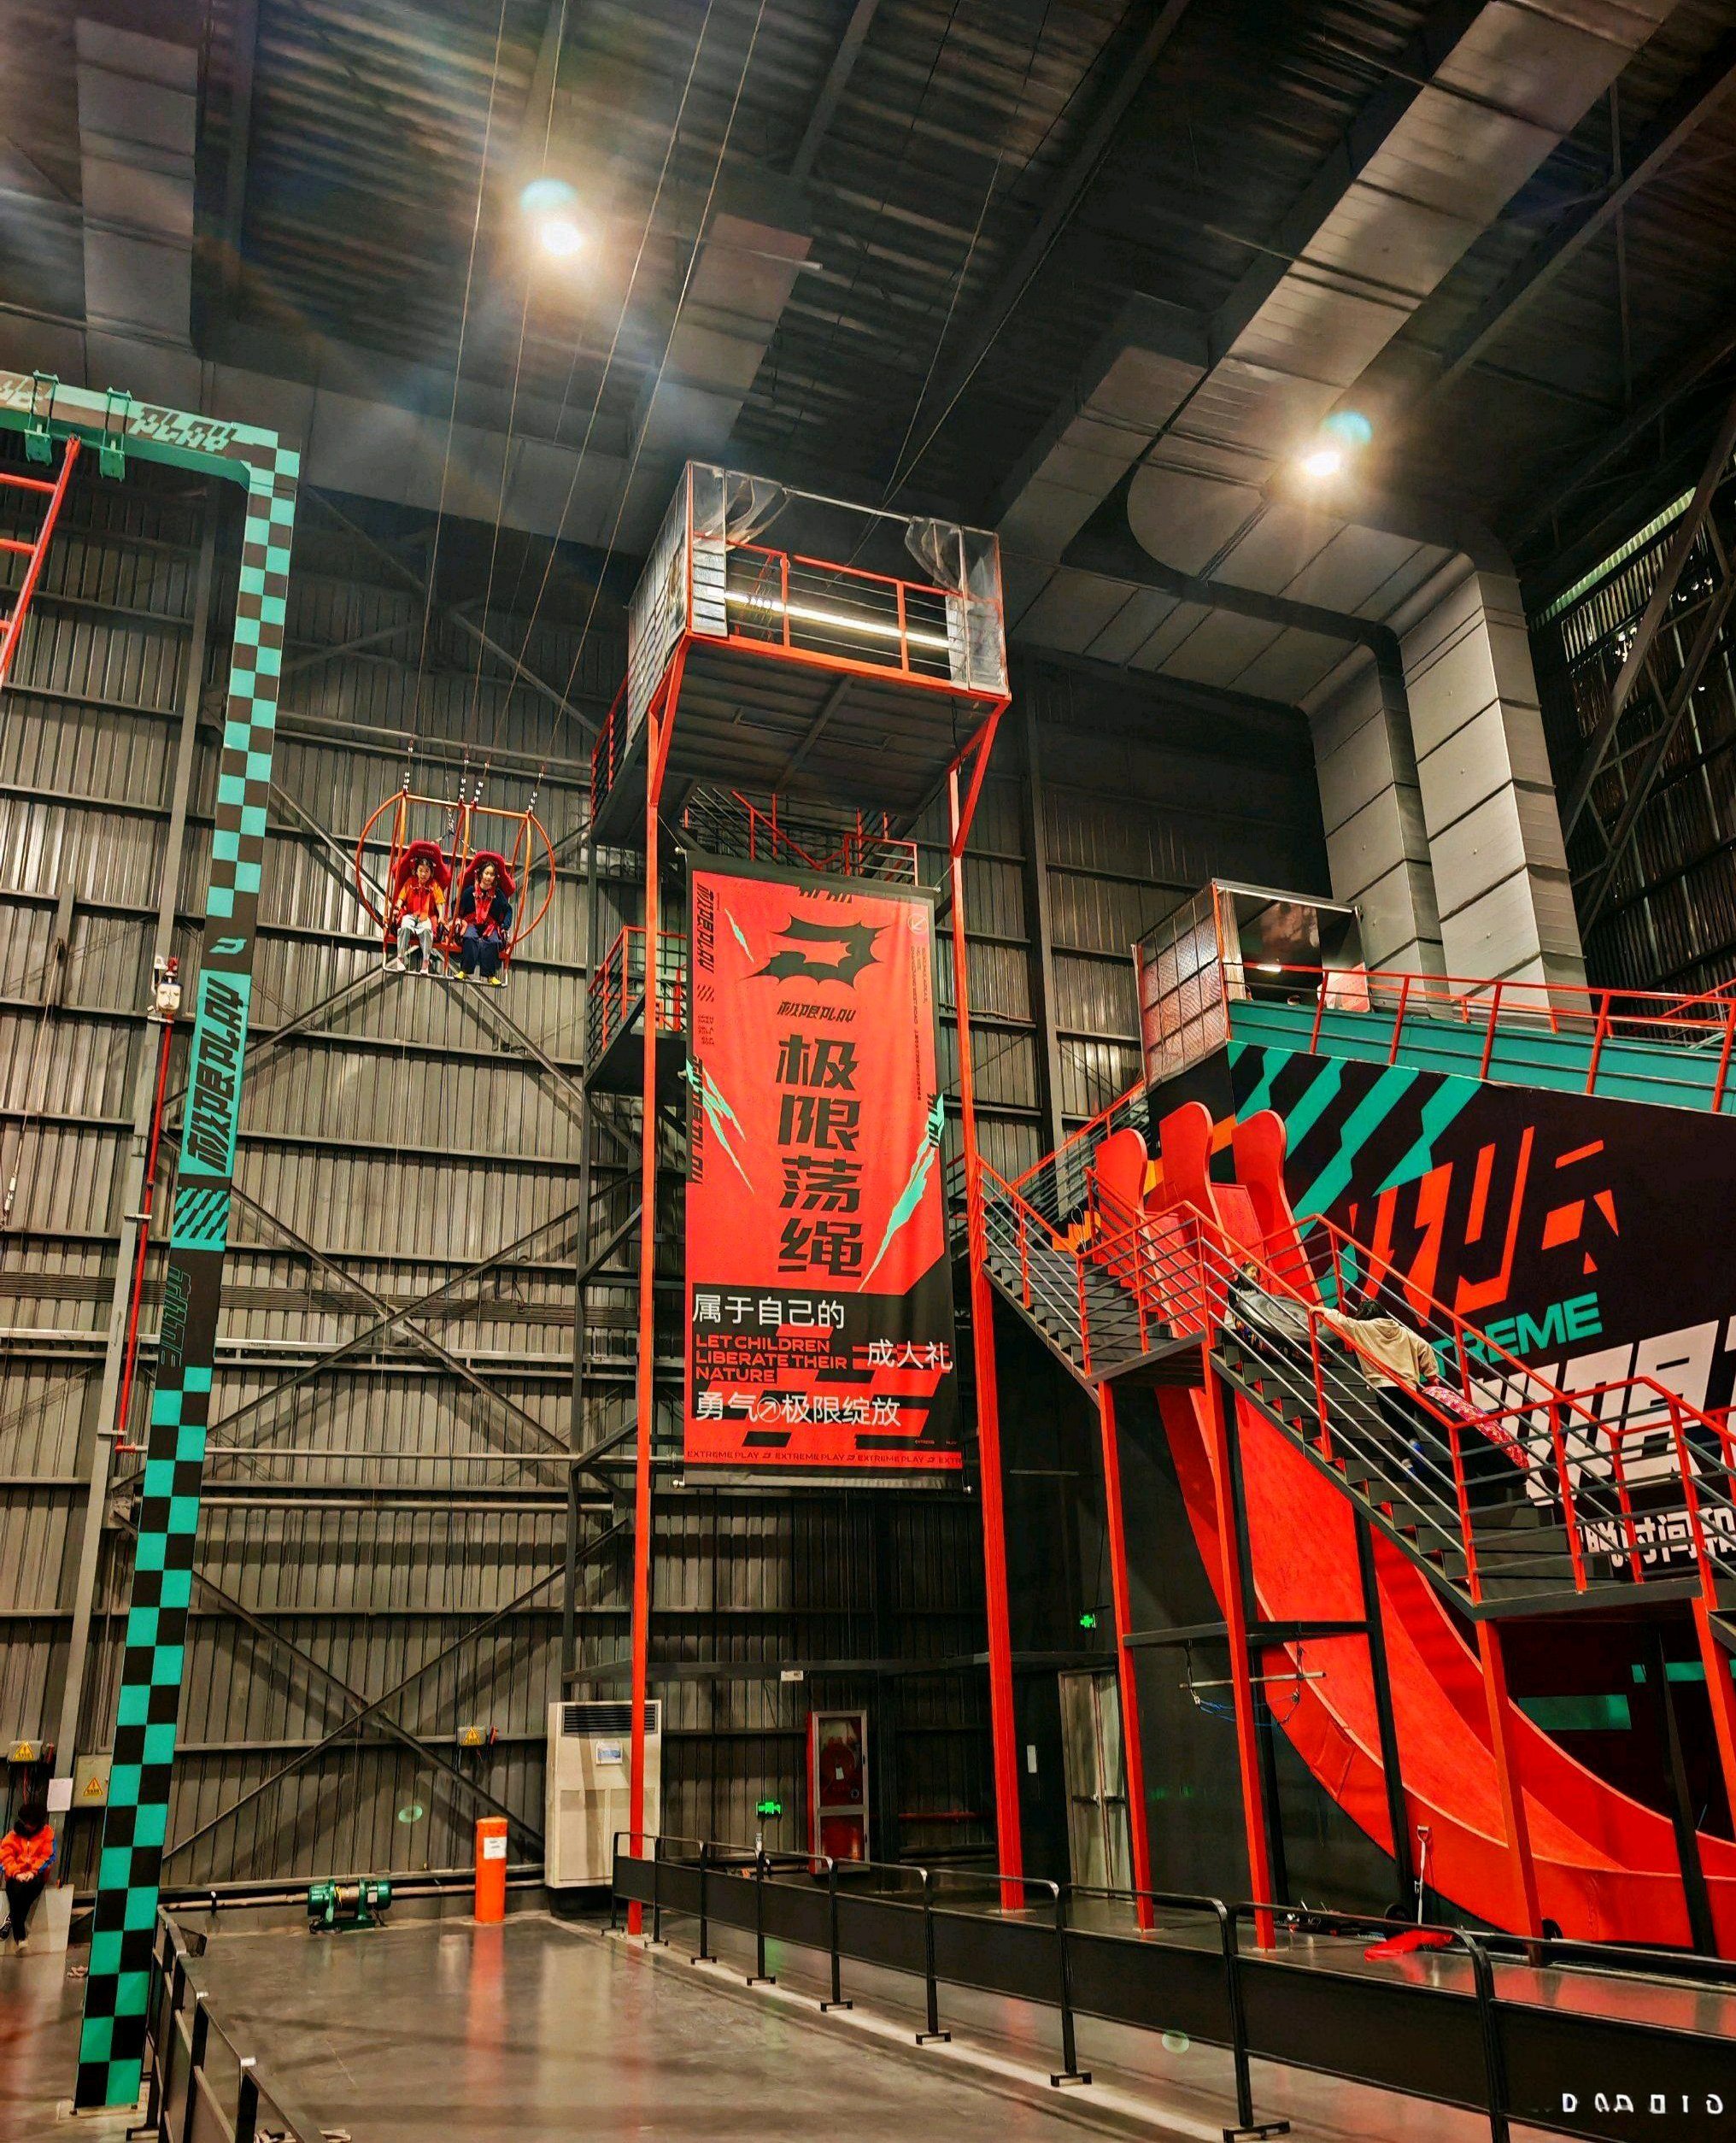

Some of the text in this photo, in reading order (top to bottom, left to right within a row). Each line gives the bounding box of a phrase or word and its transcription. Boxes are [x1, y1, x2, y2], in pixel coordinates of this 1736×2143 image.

[775, 1033, 865, 1278] 极限荡绳
[692, 1293, 846, 1330] 属于自己的
[695, 1333, 830, 1353] LET CHILDREN
[866, 1338, 954, 1372] 成人礼
[695, 1350, 848, 1371] LIBERATE THEIR
[695, 1366, 776, 1383] NATURE
[696, 1391, 902, 1427] 勇气 极限绽放
[821, 1453, 844, 1462] PLAY
[901, 1455, 924, 1464] PLAY
